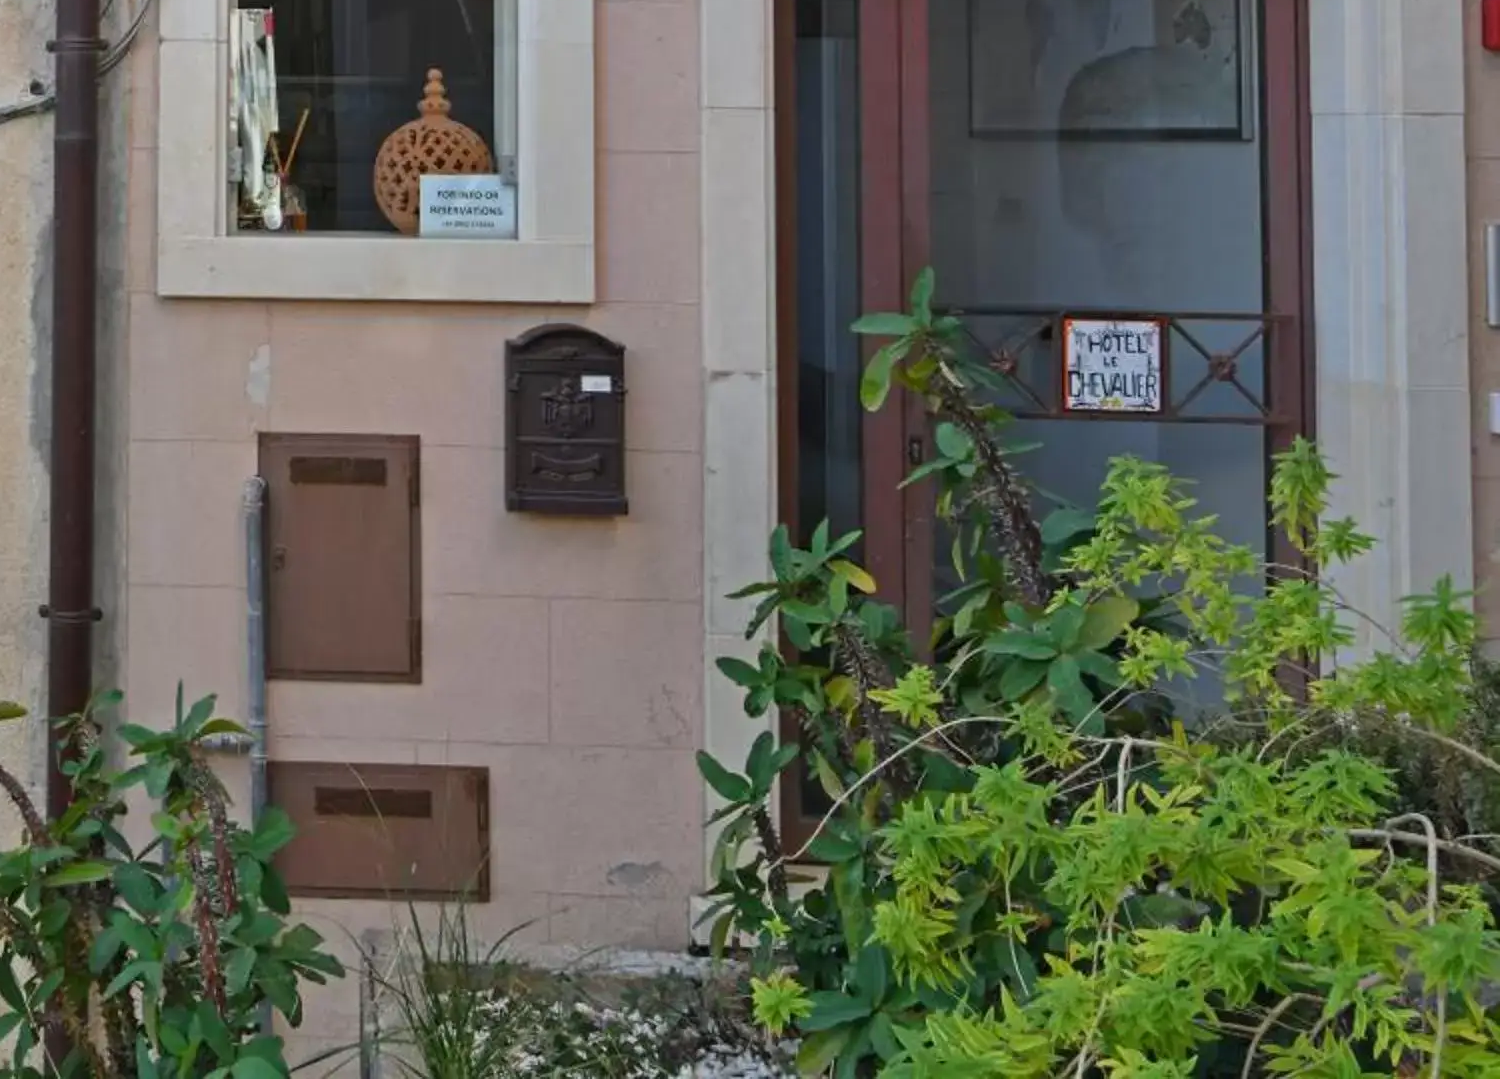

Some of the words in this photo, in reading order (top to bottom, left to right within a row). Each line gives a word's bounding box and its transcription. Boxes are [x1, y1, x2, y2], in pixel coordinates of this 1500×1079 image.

[437, 190, 456, 200] FOR
[458, 190, 482, 200] INFO
[429, 205, 503, 216] RESERVATIONS
[1088, 333, 1147, 354] HOTEL
[1103, 356, 1118, 368] LE
[1068, 370, 1157, 399] CHEVALIER
